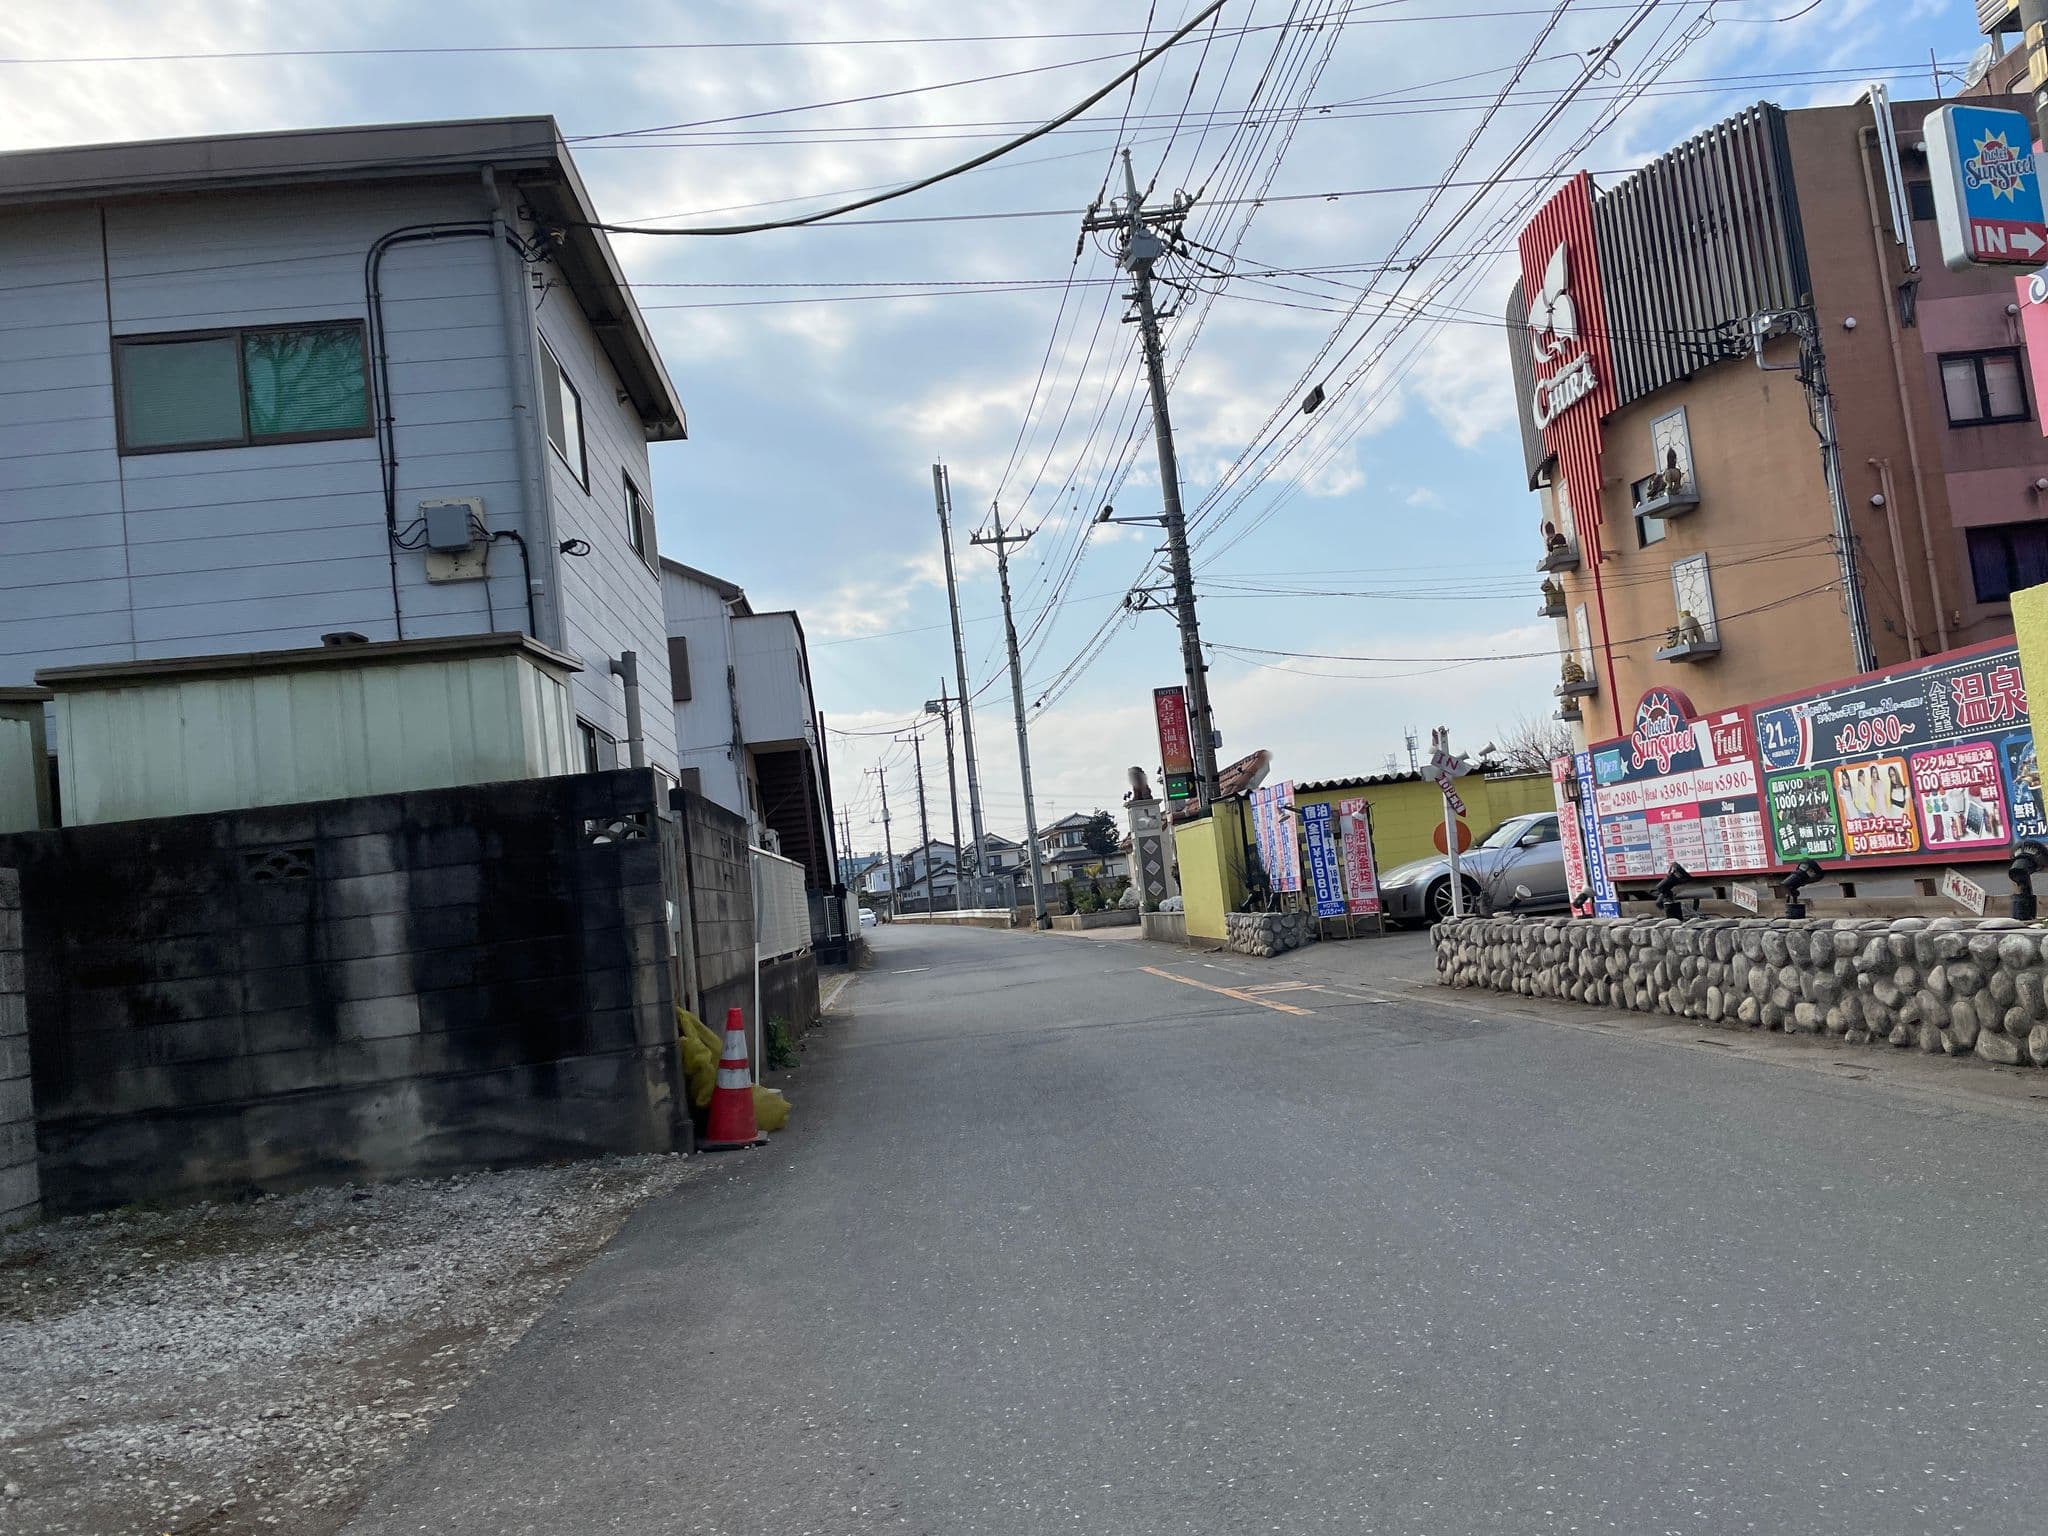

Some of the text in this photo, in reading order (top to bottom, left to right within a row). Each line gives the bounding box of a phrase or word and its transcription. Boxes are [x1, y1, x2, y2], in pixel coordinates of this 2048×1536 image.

[1974, 225, 2007, 253] IN
[1951, 665, 2029, 728] 温泉
[1647, 714, 1671, 738] hotel
[1713, 727, 1743, 756] Full
[1436, 753, 1458, 770] IN
[1697, 778, 1713, 795] Stay
[1305, 804, 1329, 819] 宿泊
[2014, 802, 2036, 818] 無料
